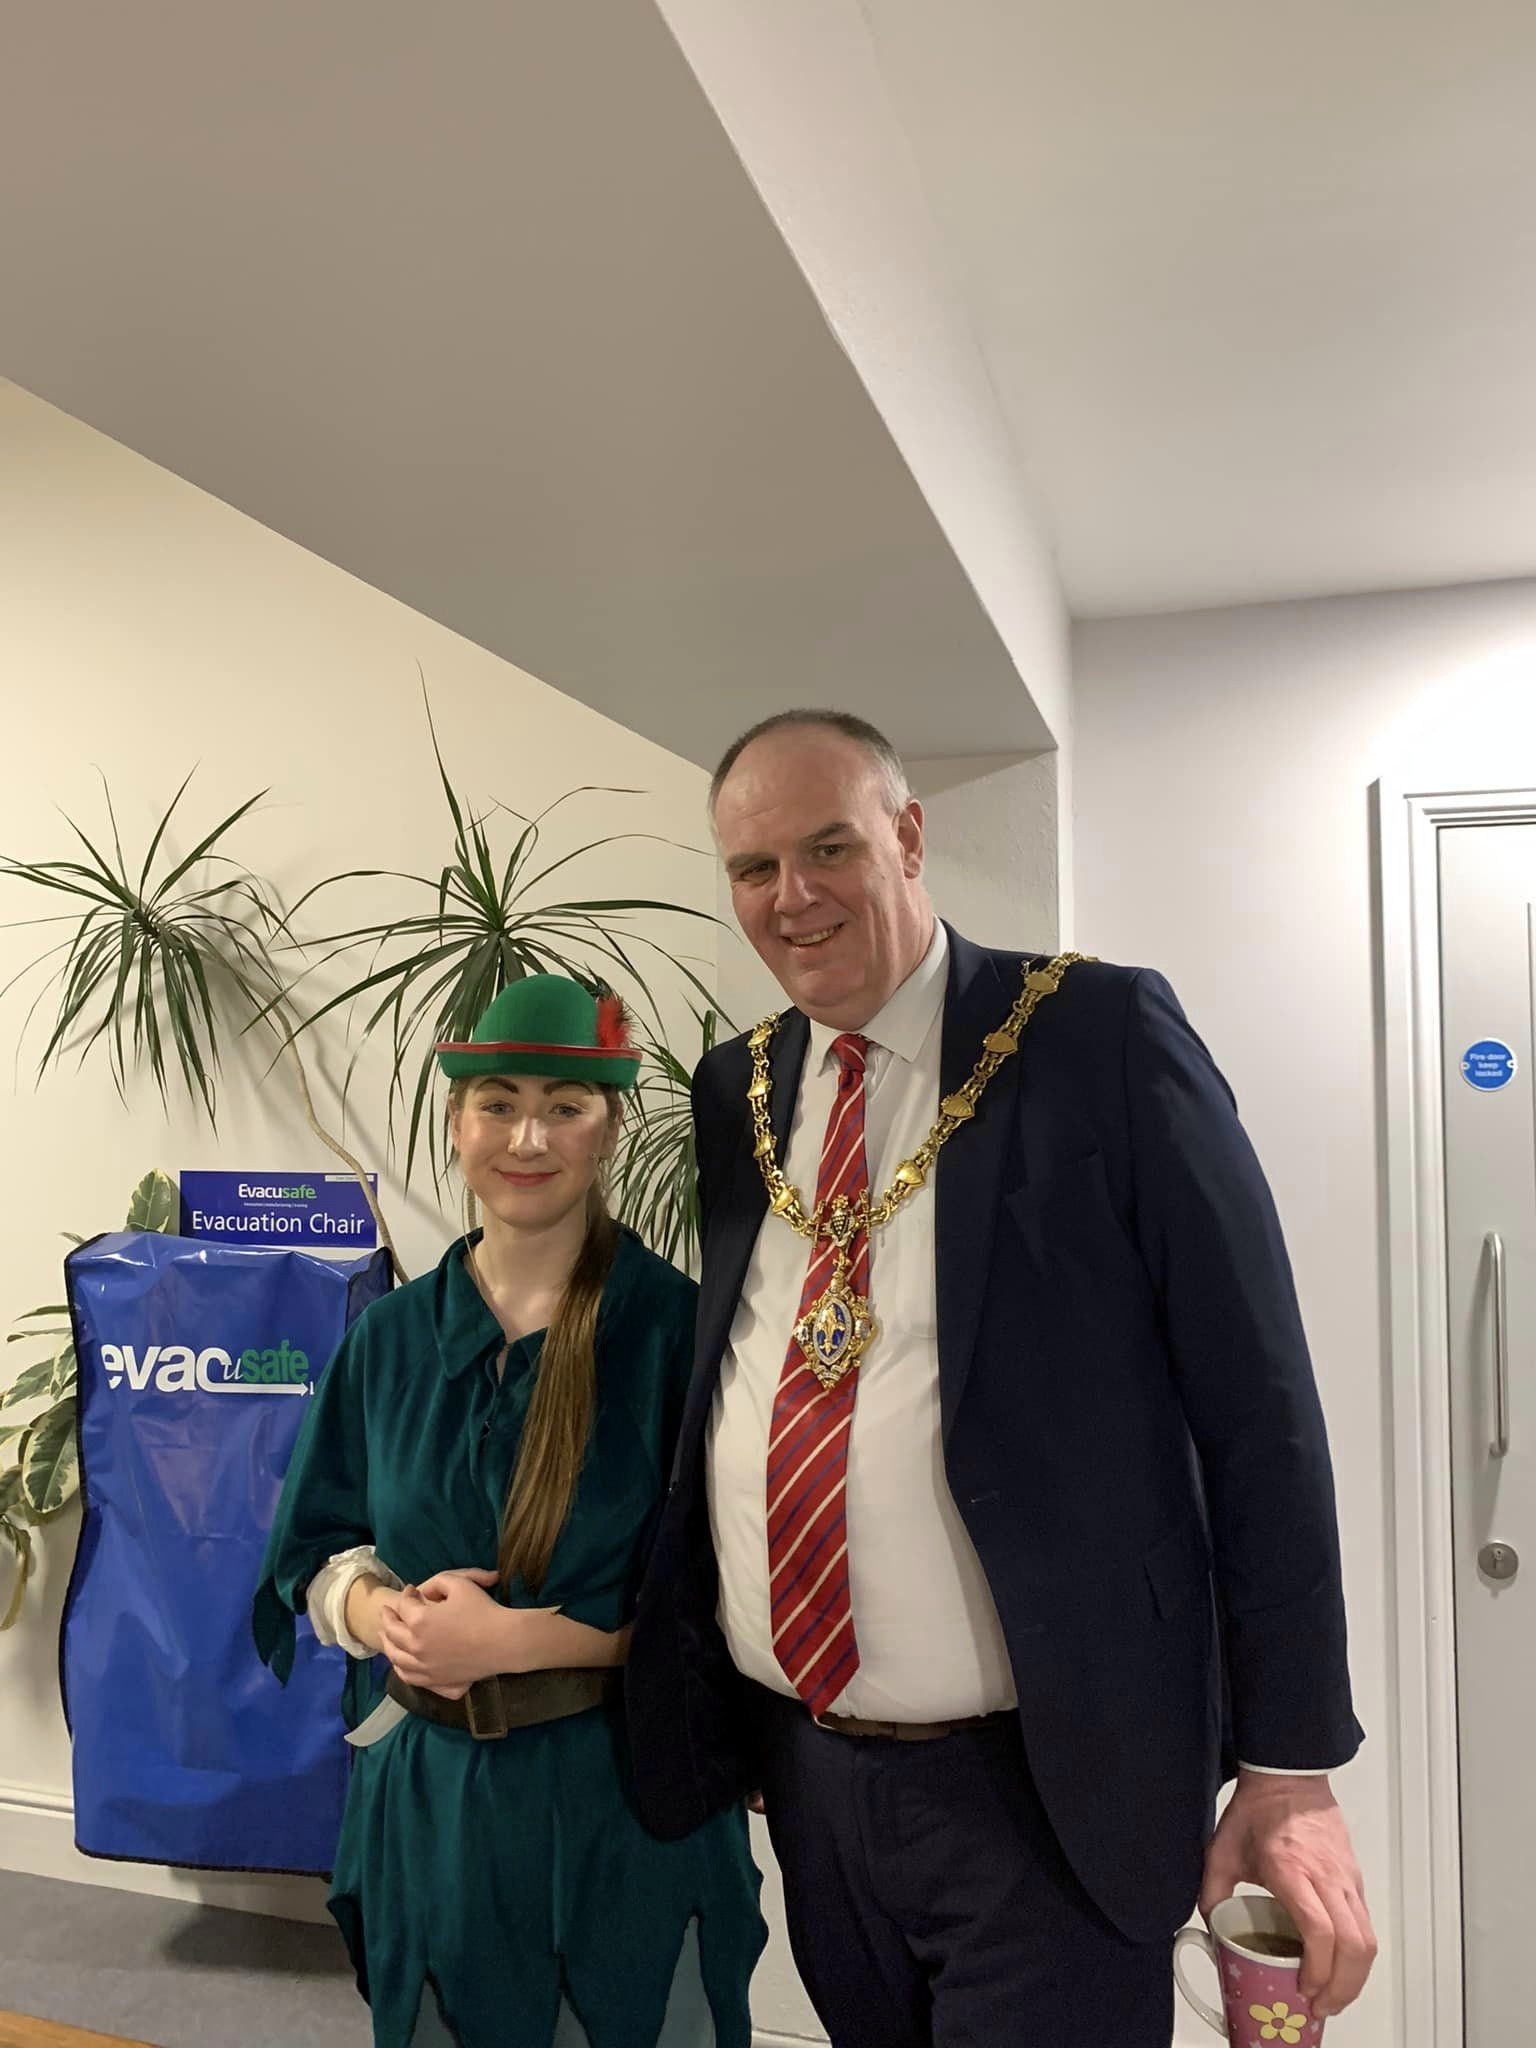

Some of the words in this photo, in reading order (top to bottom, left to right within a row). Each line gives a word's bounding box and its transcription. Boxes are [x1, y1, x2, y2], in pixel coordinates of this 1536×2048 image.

[238, 1183, 317, 1199] Evacusafe
[192, 1210, 302, 1233] Evacuation
[309, 1212, 365, 1234] Chair
